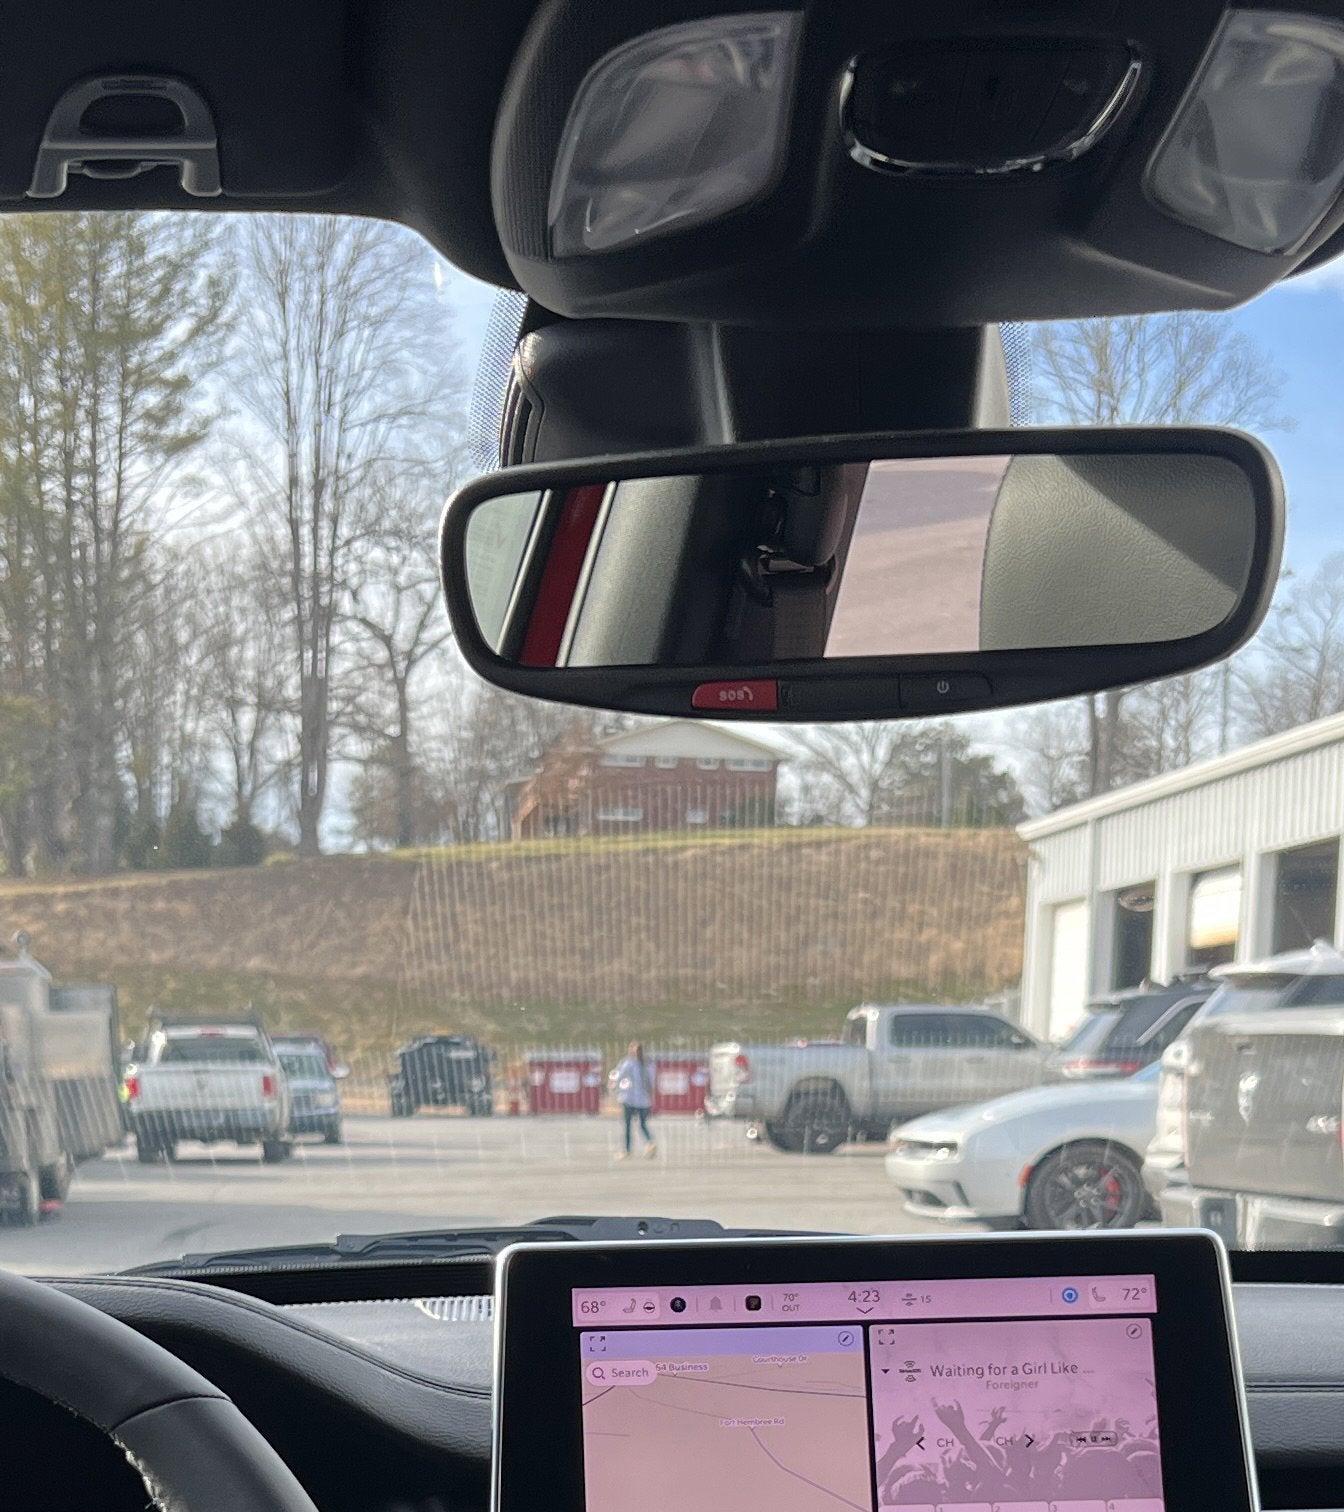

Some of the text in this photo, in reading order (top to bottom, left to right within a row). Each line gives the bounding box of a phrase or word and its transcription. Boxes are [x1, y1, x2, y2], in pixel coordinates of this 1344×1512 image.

[719, 690, 744, 701] SOS
[848, 1290, 881, 1303] 4:23
[920, 1295, 932, 1304] 15
[1121, 1287, 1148, 1301] 72°
[581, 1300, 606, 1314] 68°
[781, 1304, 800, 1312] OUT
[753, 1355, 797, 1364] Courthouse
[668, 1362, 708, 1372] Business
[930, 1363, 985, 1379] Waiting
[987, 1362, 1007, 1376] for
[1011, 1366, 1019, 1376] a
[1022, 1362, 1047, 1376] Girl
[1050, 1361, 1079, 1375] Like
[611, 1367, 649, 1379] Search
[986, 1379, 1039, 1393] Foreigner
[936, 1438, 954, 1449] CH
[996, 1436, 1014, 1447] CH
